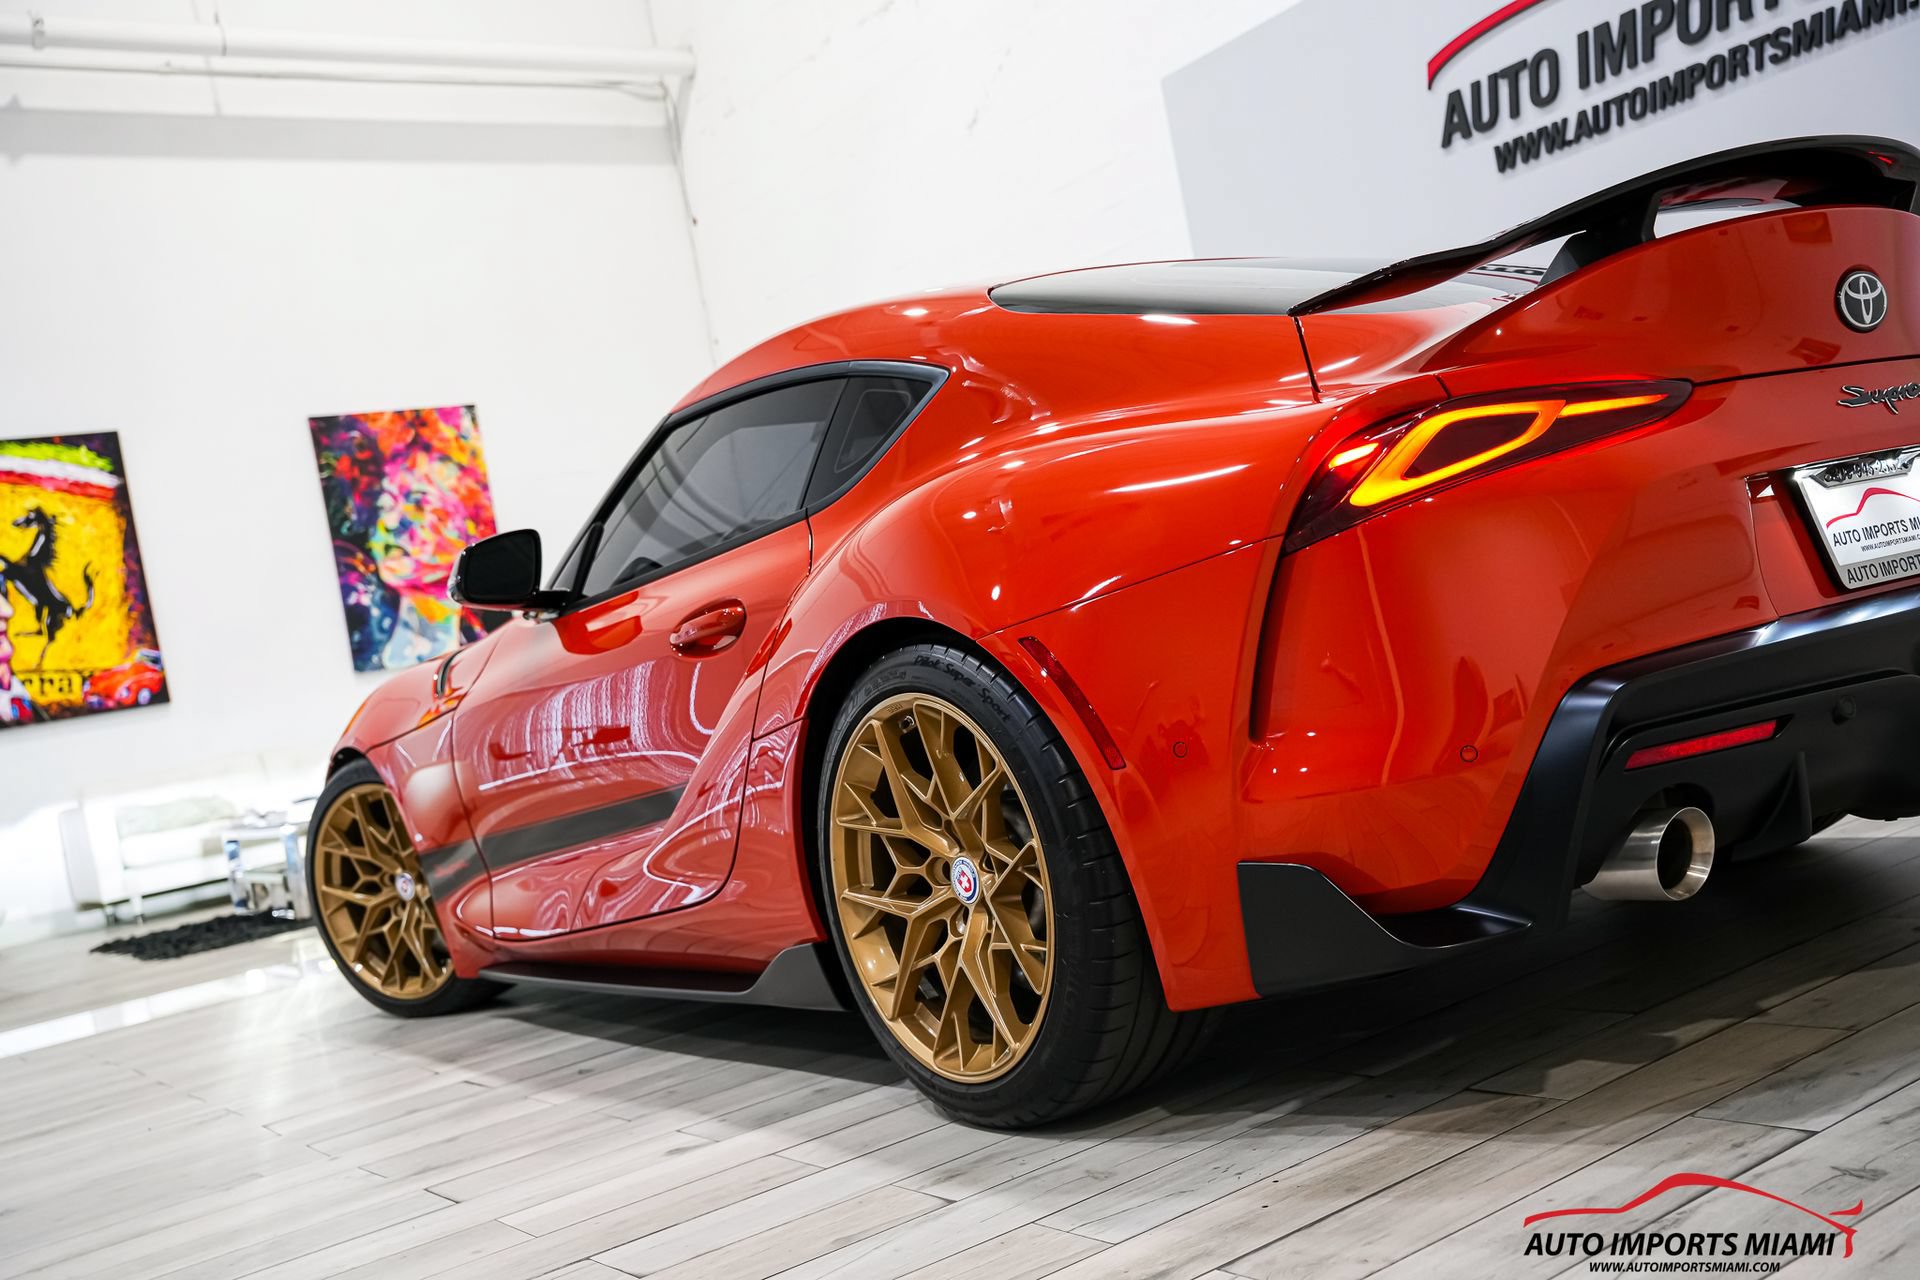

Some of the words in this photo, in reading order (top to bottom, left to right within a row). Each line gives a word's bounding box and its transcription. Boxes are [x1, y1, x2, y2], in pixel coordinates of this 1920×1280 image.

[1441, 48, 1561, 149] AUTO
[1577, 0, 1781, 90] IMPO
[1833, 529, 1861, 547] AUTO
[1862, 519, 1909, 541] IMPORTS
[1847, 563, 1879, 584] AUTO
[914, 655, 941, 669] Pilot
[943, 663, 976, 687] Super
[979, 687, 1012, 723] Sport
